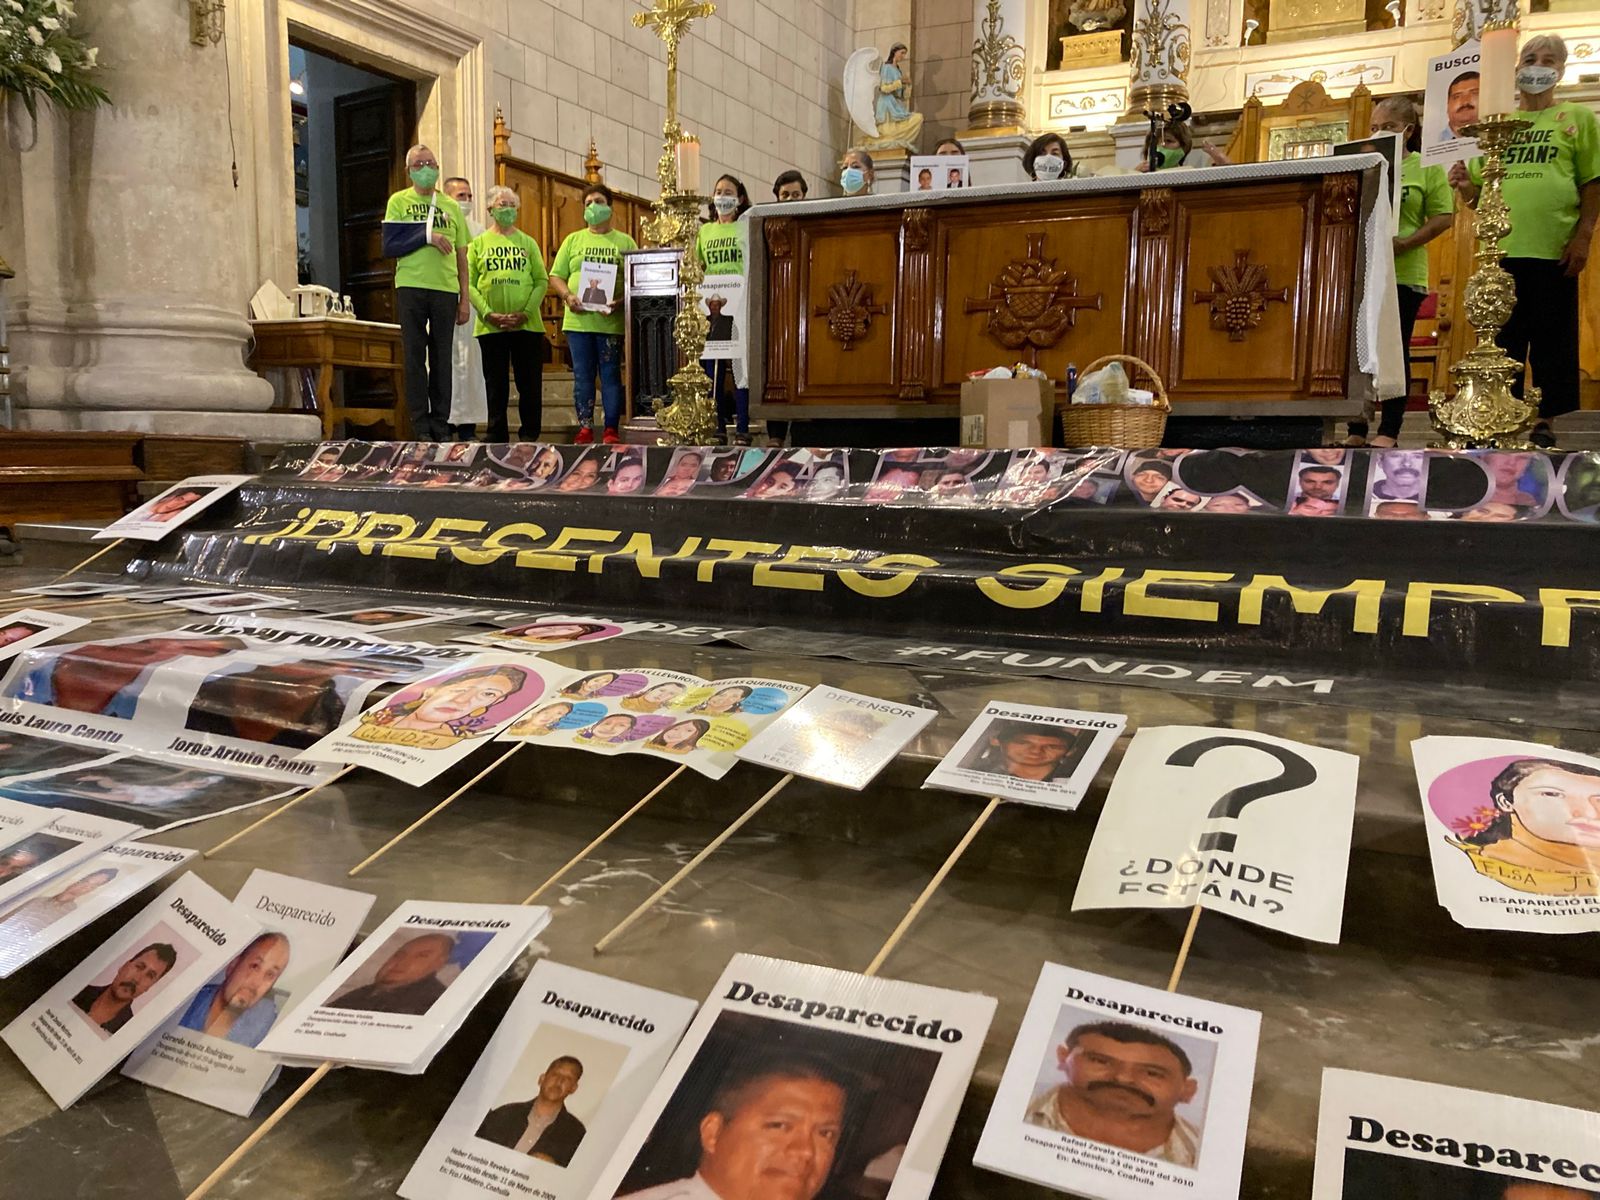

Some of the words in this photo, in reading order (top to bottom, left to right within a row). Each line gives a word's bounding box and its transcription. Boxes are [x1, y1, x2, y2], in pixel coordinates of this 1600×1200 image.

[1435, 53, 1481, 72] BUSCO
[1502, 145, 1559, 164] STAN?
[485, 257, 527, 272] ESTAN?
[698, 282, 741, 291] Desaparecido
[894, 645, 1336, 694] #FUNDEM
[745, 680, 803, 692] QUEREMOS!
[825, 691, 916, 719] DEFENSOR
[0, 708, 25, 725] uis
[24, 715, 72, 733] Lauro
[71, 724, 124, 744] Cantu
[985, 707, 1119, 730] Desaparecido
[167, 736, 213, 756] Jorge
[361, 728, 440, 746] CLAUDIA
[1164, 736, 1318, 853] ?
[104, 844, 186, 862] esaparecido
[1479, 860, 1537, 886] ELSA
[255, 895, 337, 928] Desaparecido
[1479, 895, 1581, 907] DESAPARECIÓ
[1506, 906, 1530, 915] EN:
[170, 897, 227, 947] Desaparecido
[404, 914, 512, 929] Desaparecido
[541, 990, 655, 1034] Desaparecido
[723, 980, 963, 1044] Desaparecido
[1064, 987, 1224, 1036] Desaparecido
[161, 1031, 185, 1046] Gerardo
[1024, 1135, 1079, 1155] Desaparecido
[1080, 1149, 1109, 1163] desde:
[1110, 1157, 1121, 1166] 23
[1122, 1160, 1134, 1170] de
[1135, 1164, 1156, 1177] abril
[1156, 1171, 1171, 1182] del
[1172, 1176, 1194, 1188] 2010
[1060, 1135, 1087, 1149] Rafael
[1088, 1143, 1116, 1156] Zavala
[1117, 1151, 1158, 1168] Contreras
[1346, 1114, 1600, 1183] Desaparec
[445, 1155, 481, 1175] Desaparecido
[499, 1176, 507, 1184] 11
[507, 1178, 516, 1188] de
[516, 1182, 533, 1195] Mayo
[532, 1187, 541, 1197] de
[489, 1160, 511, 1174] Reveles
[510, 1168, 530, 1181] Ramos
[1056, 1153, 1070, 1163] En:
[1071, 1157, 1115, 1176] Monclova,
[1117, 1171, 1155, 1187] Coahuila
